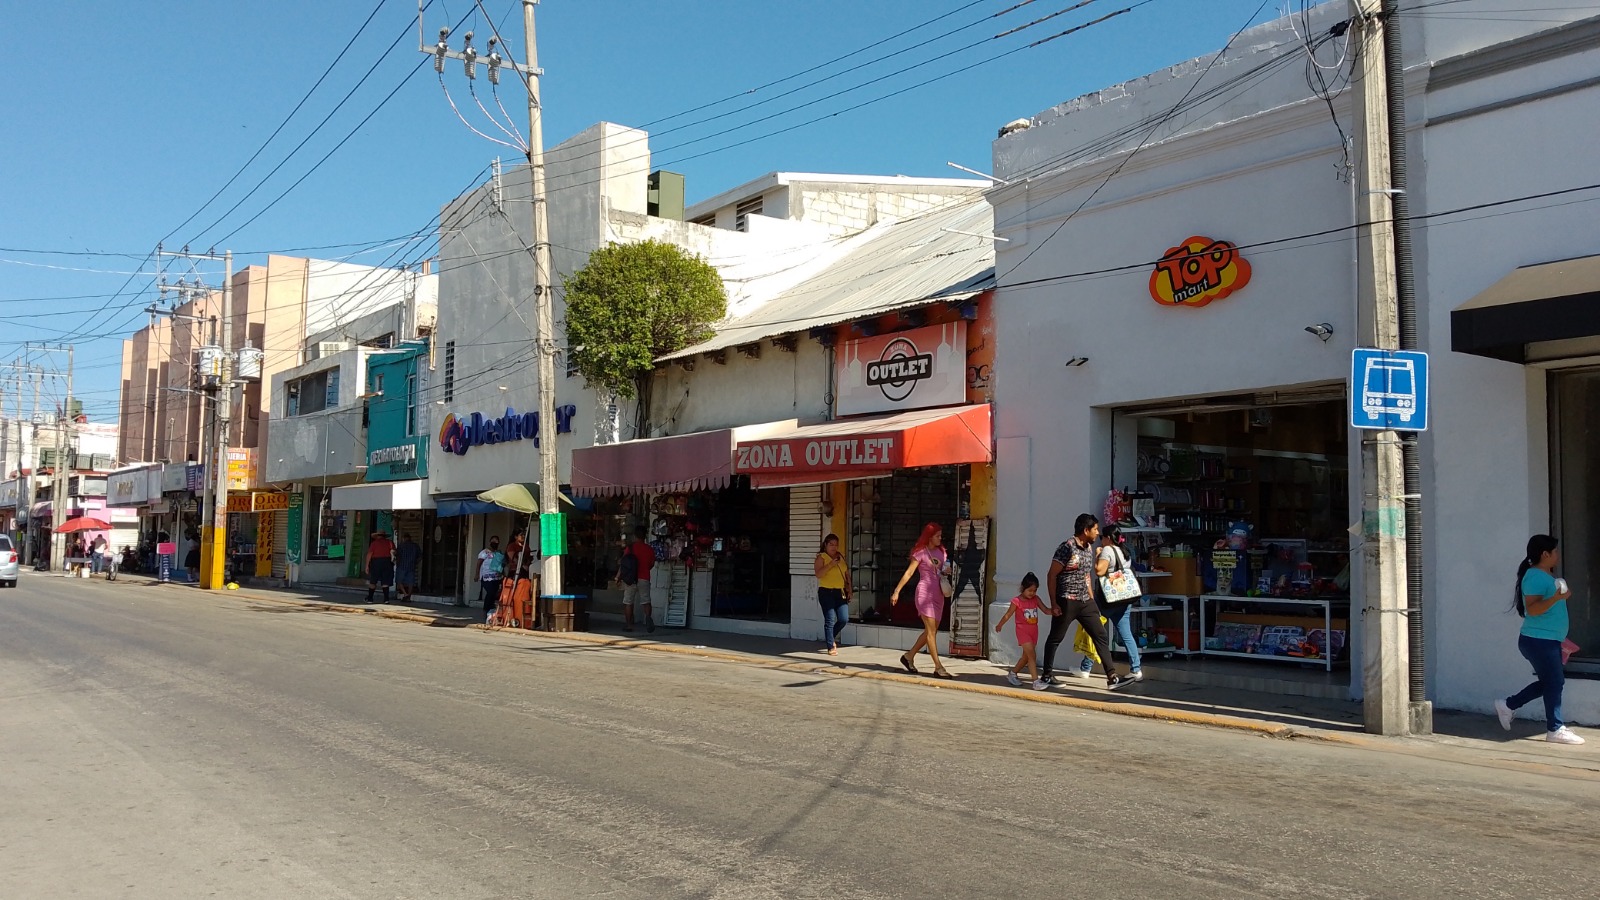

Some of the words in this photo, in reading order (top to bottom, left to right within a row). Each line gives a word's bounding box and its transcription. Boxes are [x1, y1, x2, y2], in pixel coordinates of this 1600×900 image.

[1174, 278, 1208, 303] mart
[868, 358, 929, 381] OUTLET
[737, 443, 794, 469] ZONA
[805, 437, 894, 466] OUTLET
[255, 494, 288, 505] ORO
